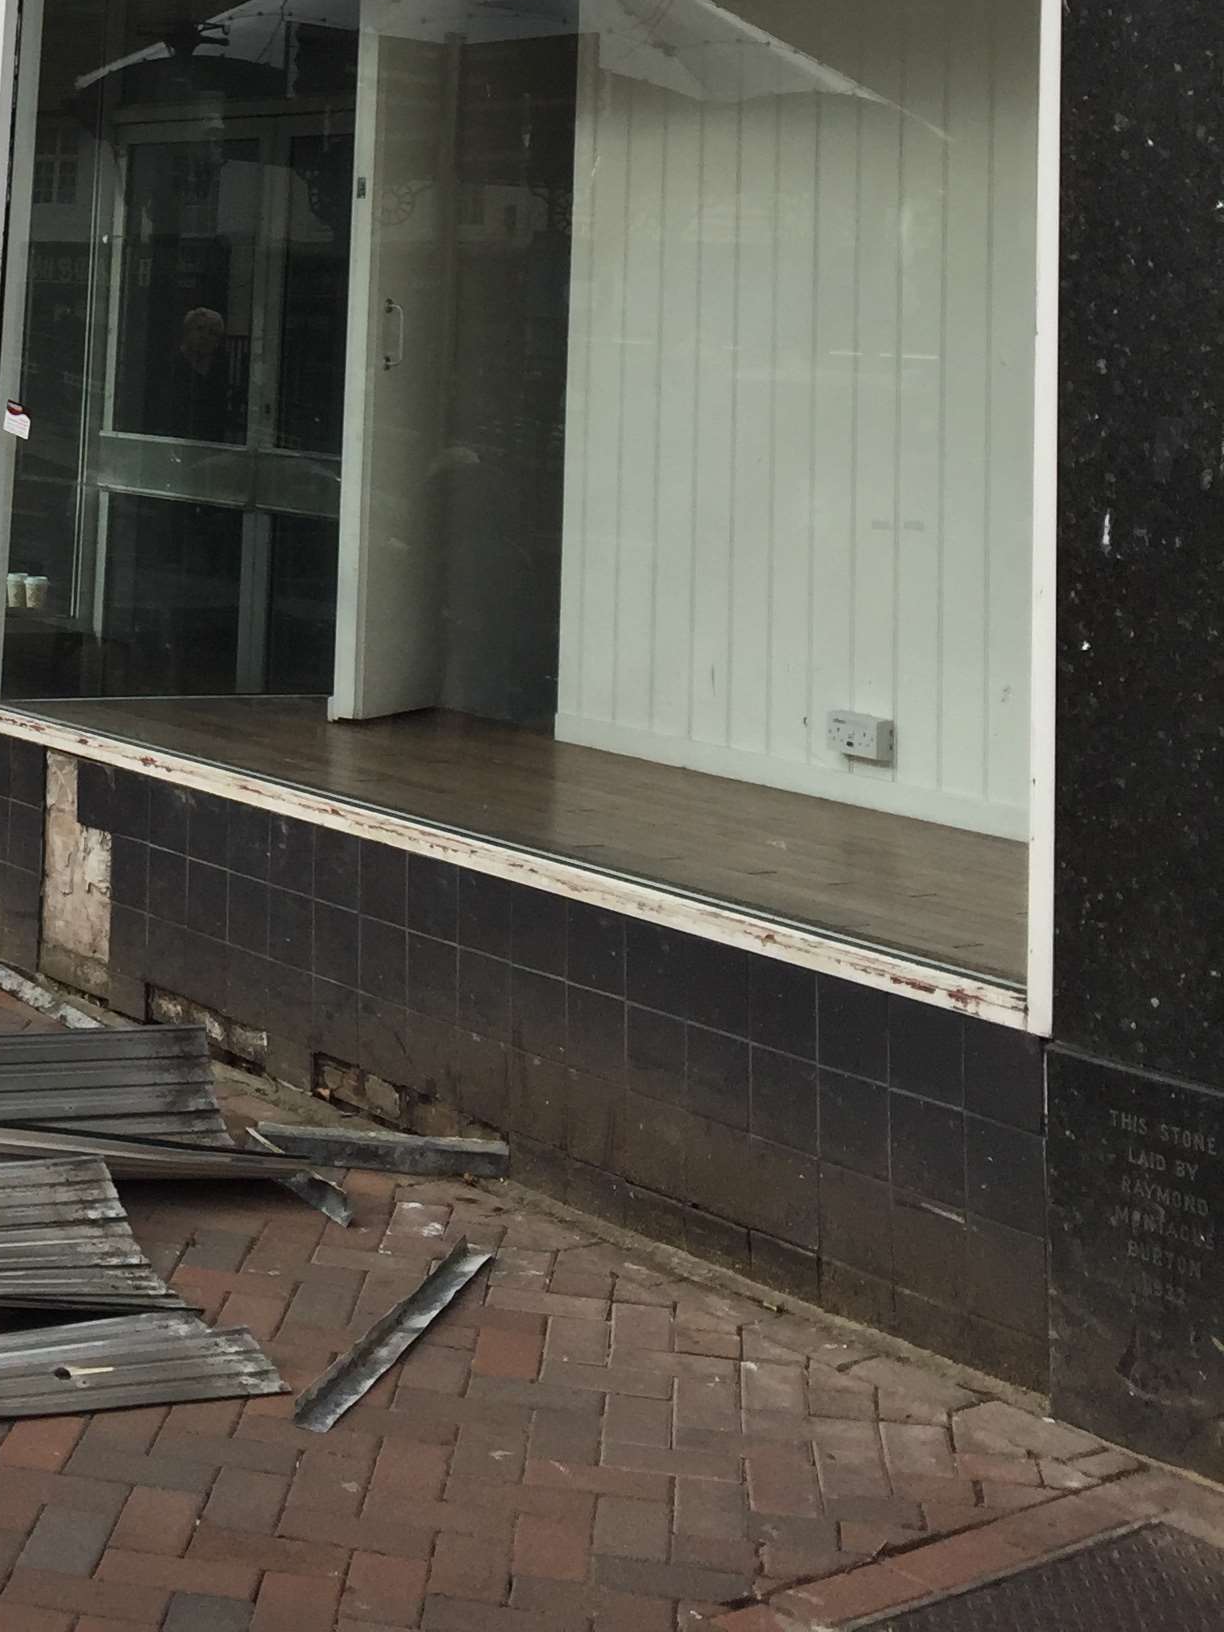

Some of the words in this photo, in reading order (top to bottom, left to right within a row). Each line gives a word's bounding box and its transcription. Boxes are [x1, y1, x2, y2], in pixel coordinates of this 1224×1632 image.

[1109, 1109, 1147, 1135] THIS
[1160, 1123, 1216, 1156] STONE
[1128, 1146, 1166, 1171] LAID
[1175, 1159, 1199, 1182] BY
[1121, 1175, 1209, 1217] RAYMOND
[1127, 1239, 1202, 1280] BURTON
